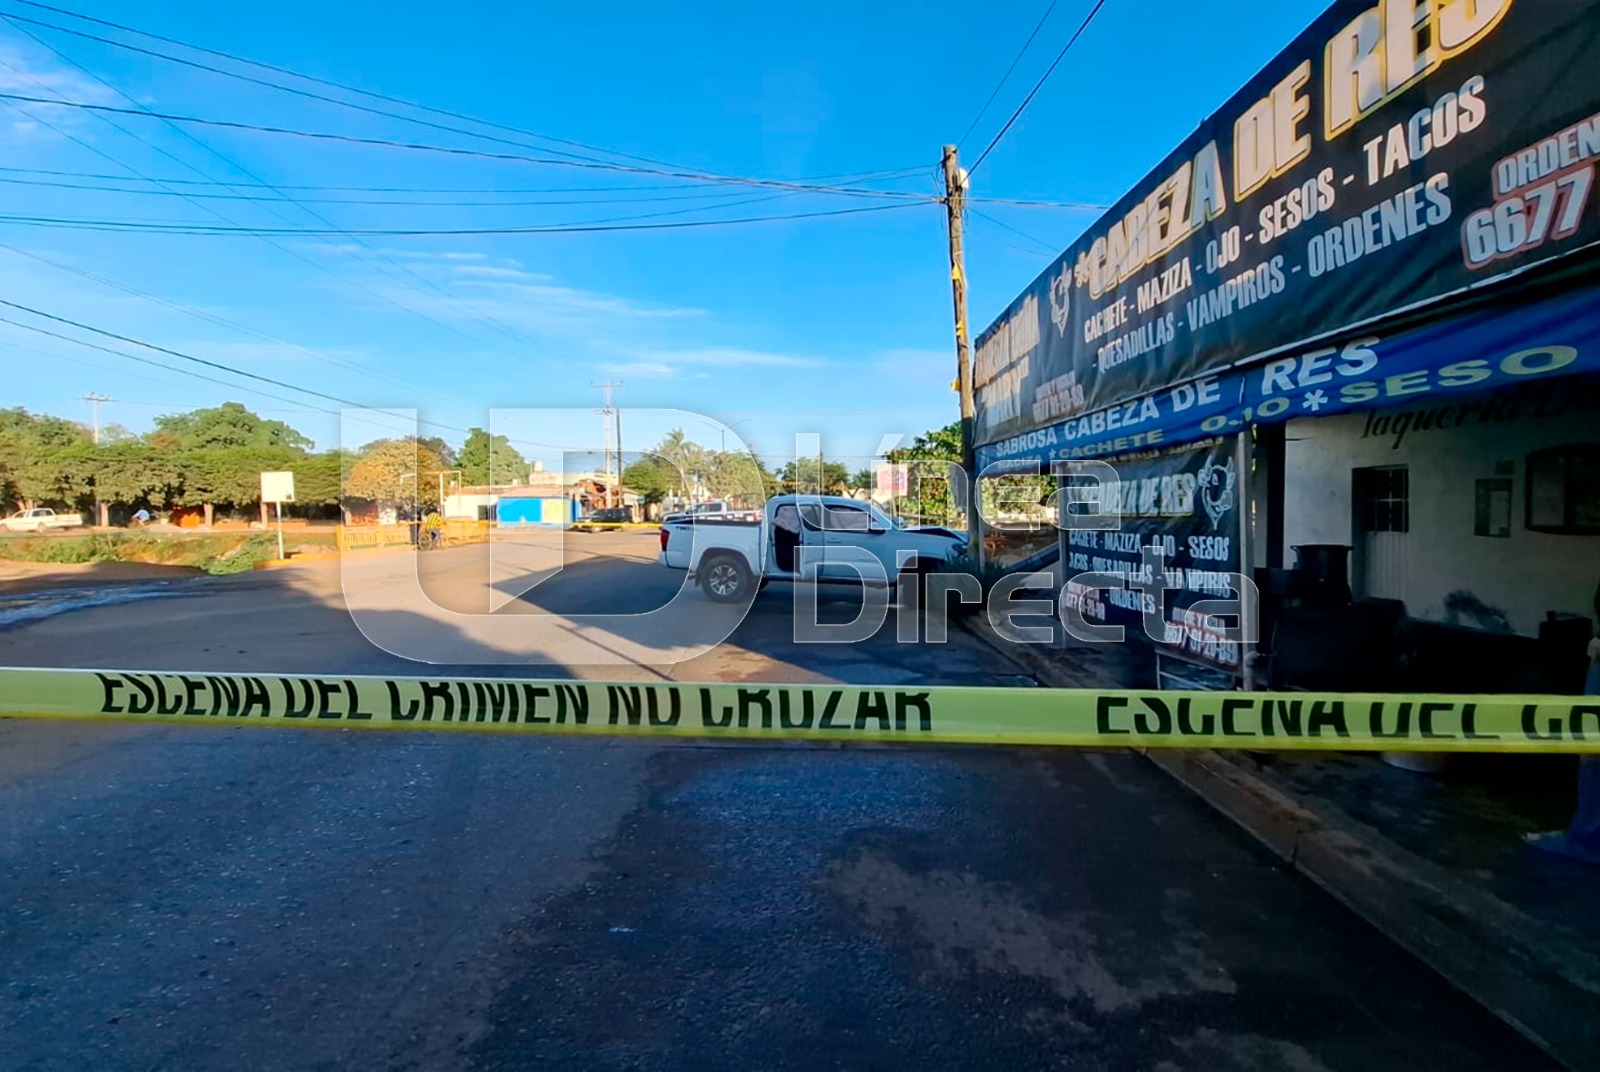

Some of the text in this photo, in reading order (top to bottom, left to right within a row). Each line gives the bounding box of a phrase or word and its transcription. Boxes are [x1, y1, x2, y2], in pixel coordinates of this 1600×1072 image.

[1084, 296, 1129, 343] CACHETE
[1137, 257, 1192, 314] MAZIZA
[1205, 225, 1241, 275] OJO
[1259, 166, 1336, 244] SESOS
[1363, 75, 1486, 186] TACOS
[1088, 139, 1227, 300] CABEZA
[1233, 59, 1311, 202] DE
[1463, 165, 1593, 266] 6677
[1097, 311, 1175, 374] QUESADILLAS
[1186, 254, 1286, 332] VAMPIROS
[1307, 172, 1452, 278] ORDENES
[996, 428, 1058, 457] SABROSA
[1064, 397, 1159, 441] CABEZA
[1170, 375, 1220, 412] DE
[1261, 336, 1380, 395] RES
[1059, 428, 1164, 459] CACHETE
[1340, 345, 1578, 403] SESO
[1105, 531, 1142, 554] MAZIZA
[1152, 534, 1175, 557] OJO
[1188, 536, 1230, 561] SESOS
[1109, 586, 1156, 615] ORDENES
[96, 671, 272, 718] ESCENA
[279, 678, 373, 721] DEL
[385, 680, 589, 726] CRIMEN
[607, 685, 681, 727] NO
[700, 687, 932, 732] CRUZAR
[1095, 695, 1351, 738] ESCENA
